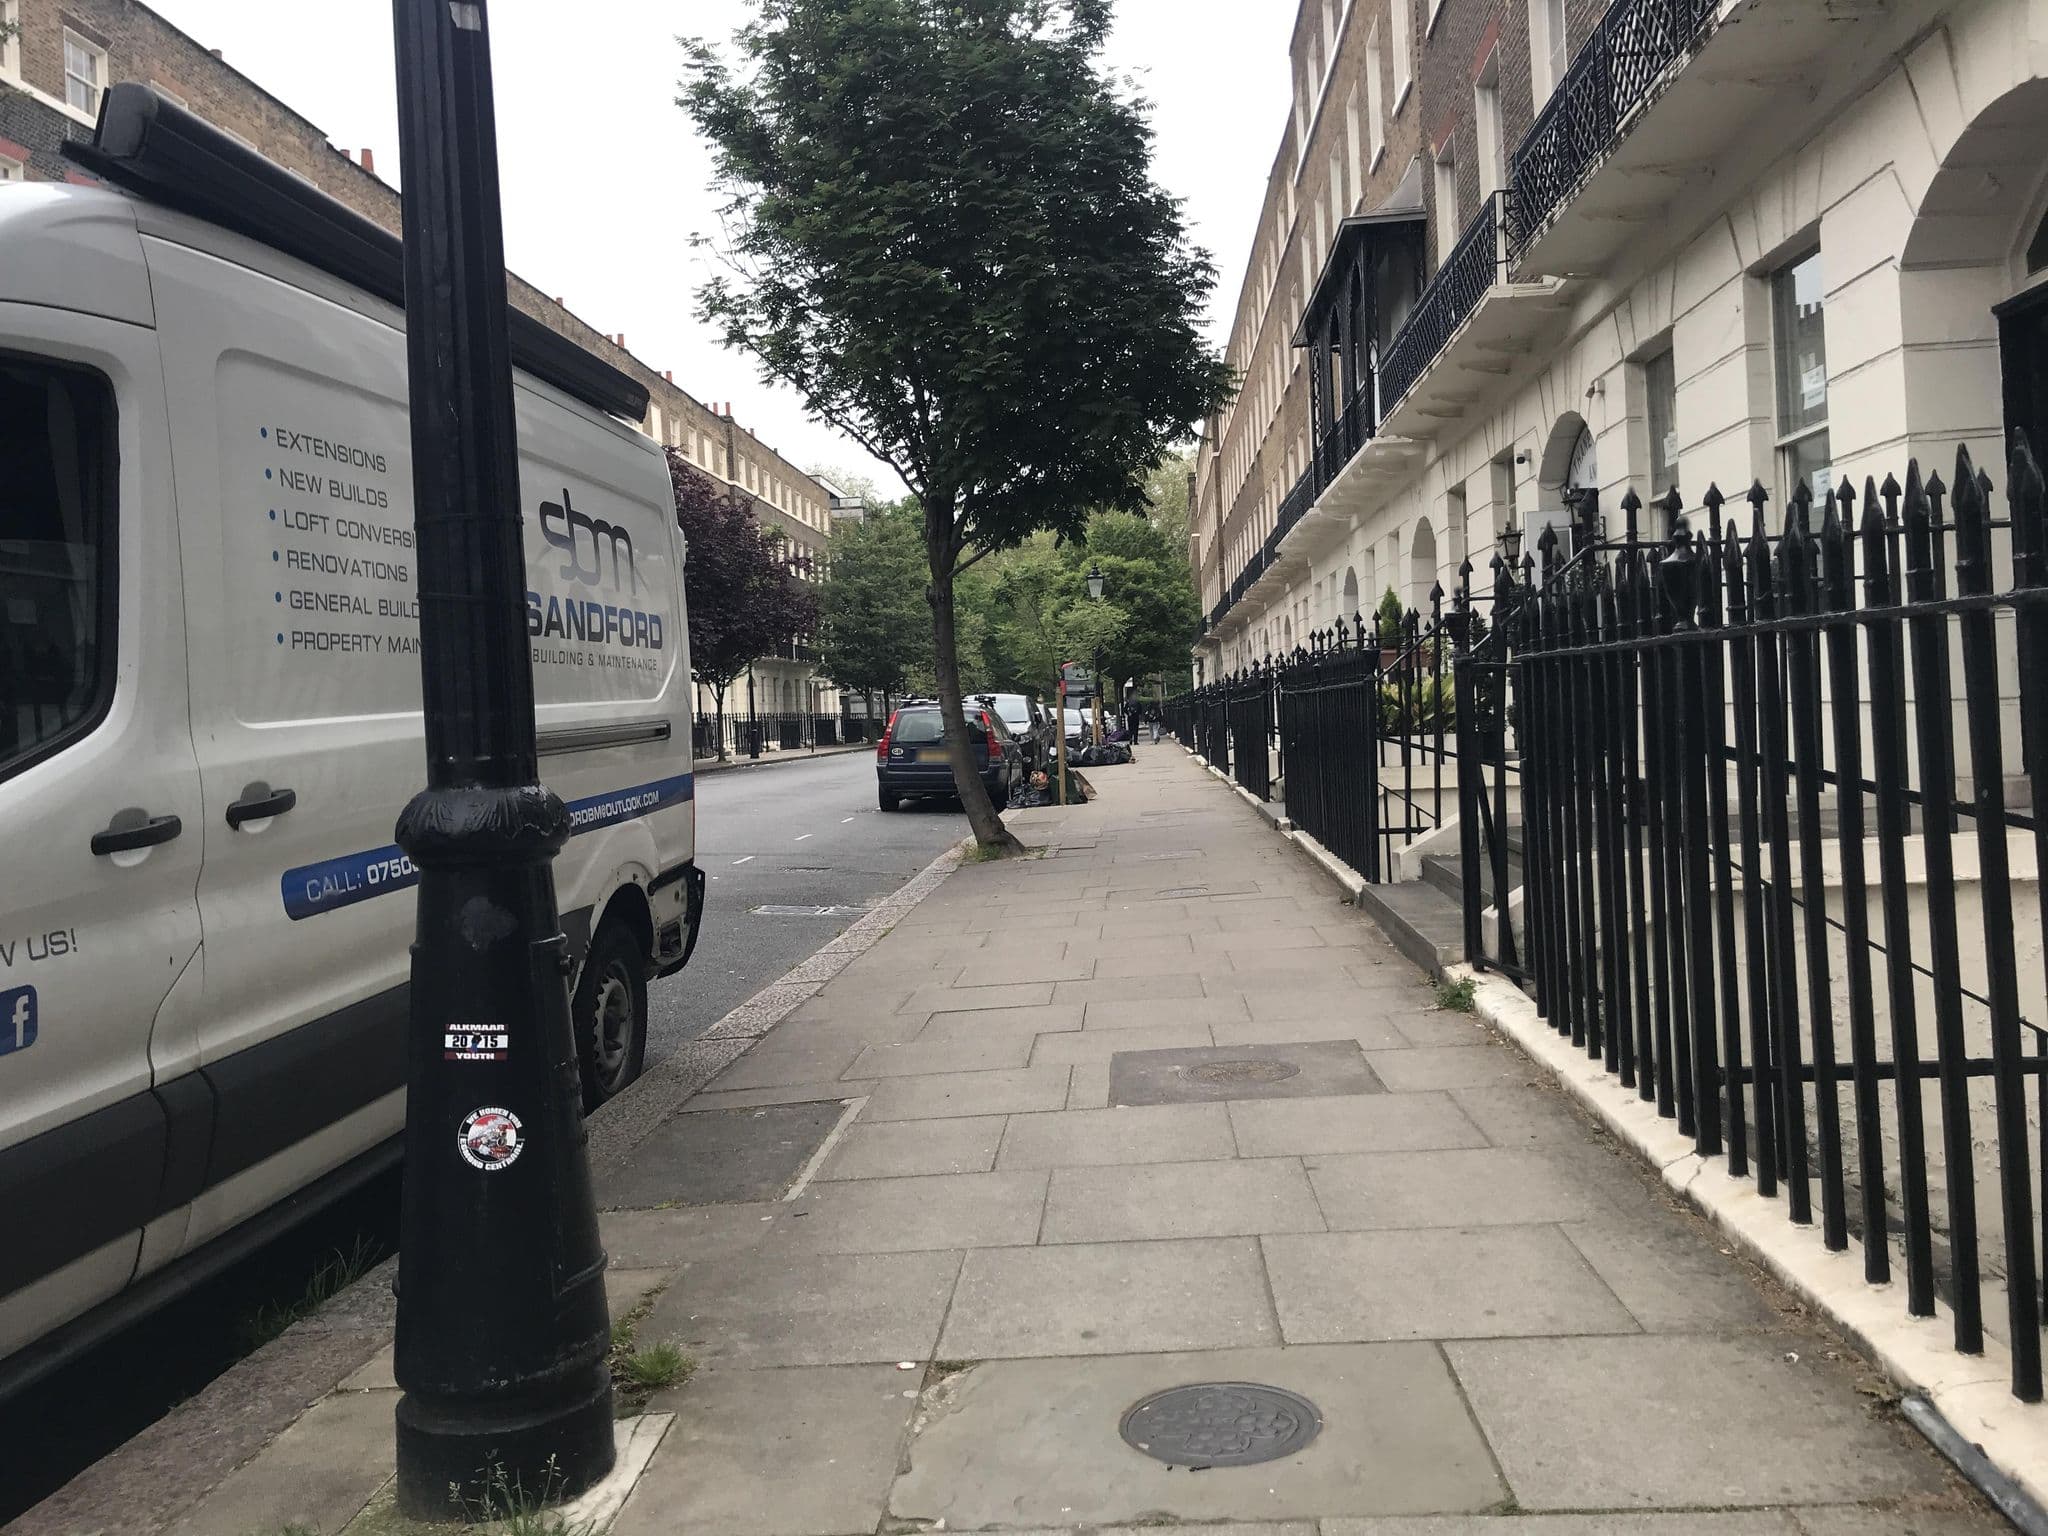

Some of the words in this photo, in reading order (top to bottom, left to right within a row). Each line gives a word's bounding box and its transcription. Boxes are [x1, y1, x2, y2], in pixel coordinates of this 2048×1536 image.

[276, 428, 387, 473] EXTENSIONS
[280, 468, 322, 494] NEW
[329, 480, 388, 509] BUILDS
[284, 509, 330, 535] LOFT
[287, 549, 408, 583] RENOVATIONS
[290, 591, 373, 615] GENERAL
[527, 591, 663, 650] SANDFORD
[292, 631, 382, 653] PROPERTY
[532, 648, 583, 665] BUILDING
[588, 653, 594, 666] &
[598, 655, 657, 671] MAINTENANCE
[306, 872, 362, 903] CALL:
[27, 928, 77, 961] US!
[449, 1023, 505, 1031] ALKMAAR
[452, 1035, 468, 1048] 20
[484, 1035, 498, 1048] 15
[456, 1052, 495, 1060] YOUTH
